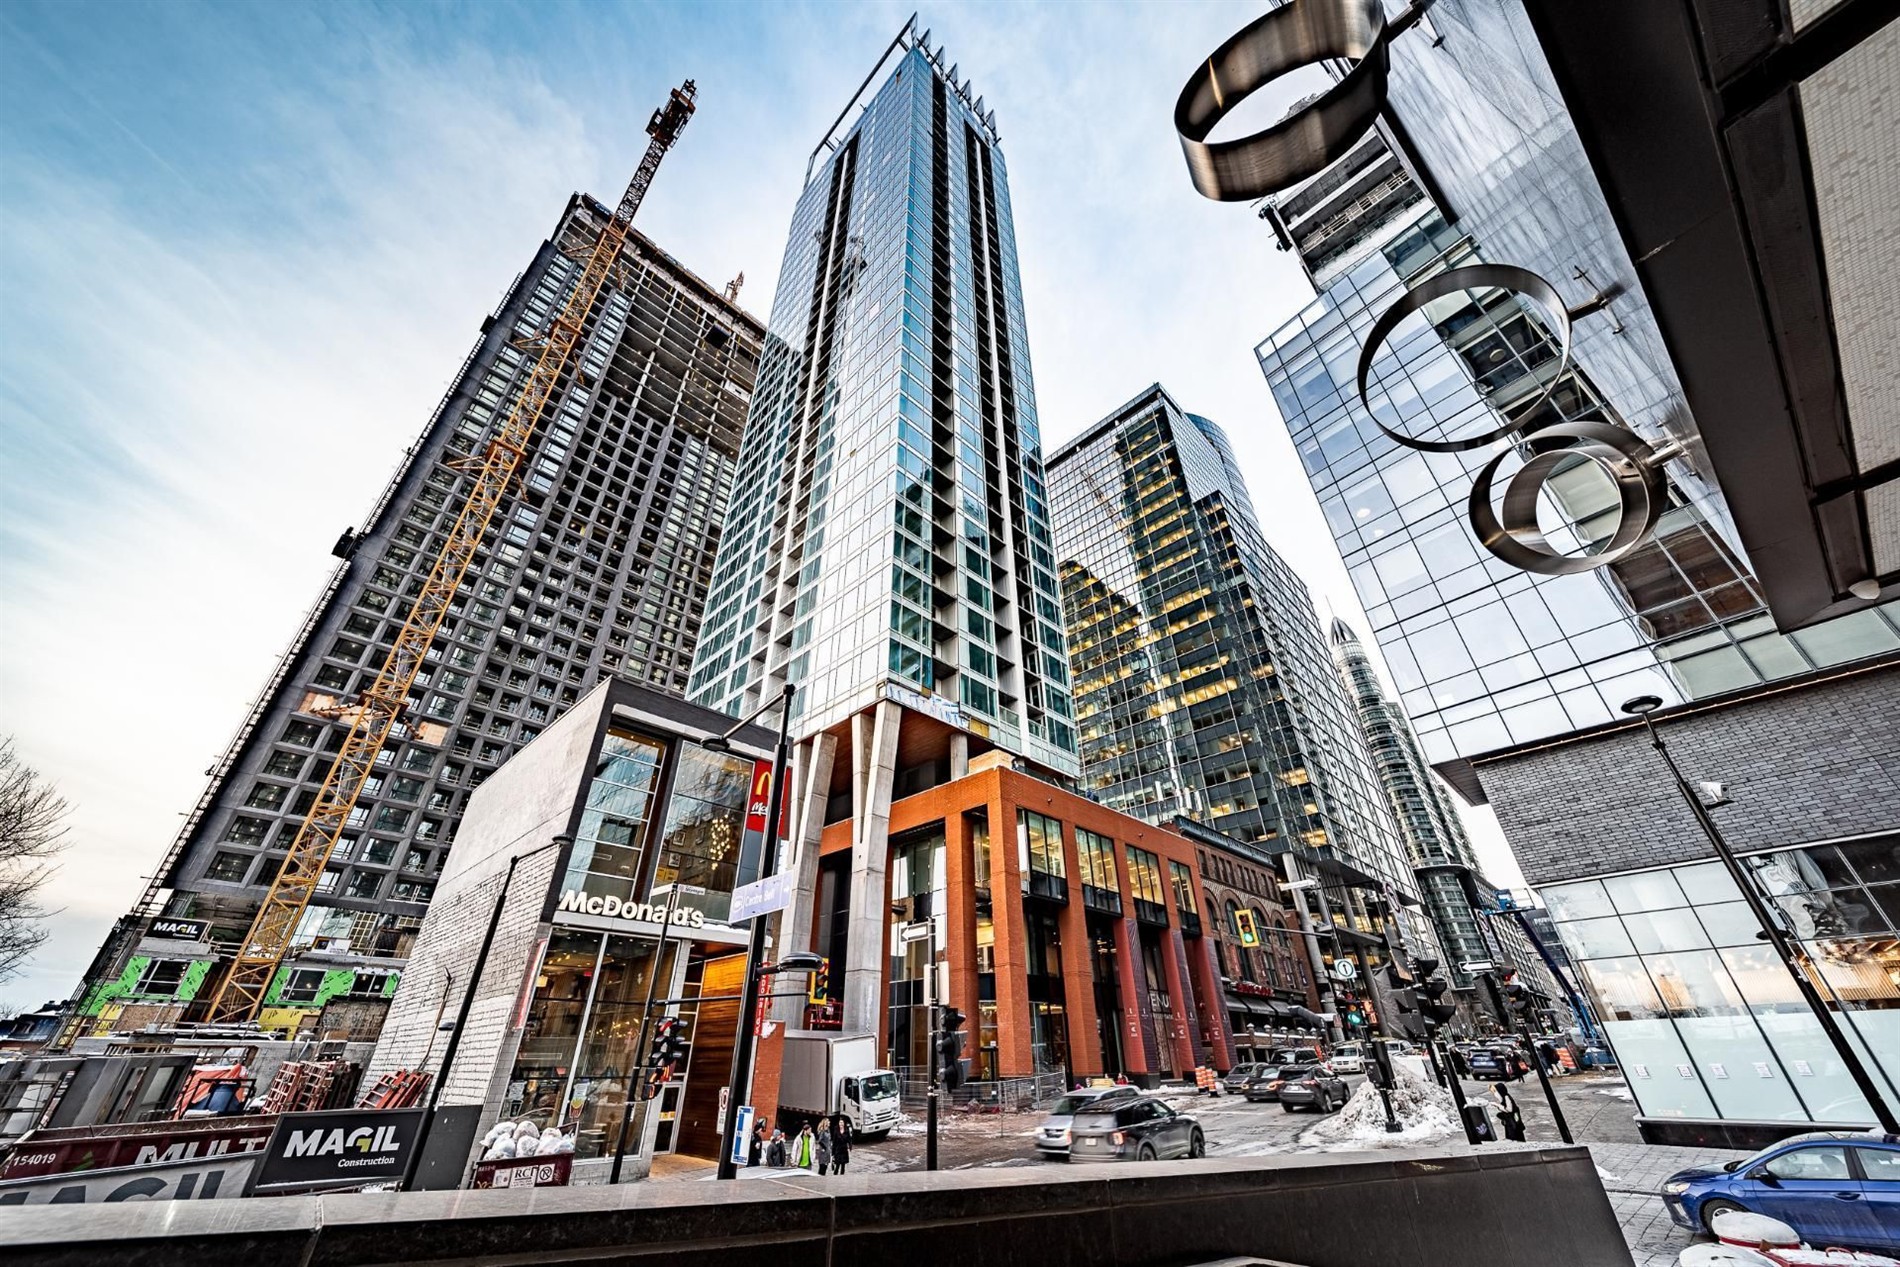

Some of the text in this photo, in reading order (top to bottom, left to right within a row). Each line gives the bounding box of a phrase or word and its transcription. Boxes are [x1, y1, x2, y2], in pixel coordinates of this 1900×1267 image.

[153, 921, 198, 934] MAGIL
[282, 1125, 400, 1158] MAGIL
[13, 1153, 57, 1167] 154019
[337, 1156, 395, 1168] Construction
